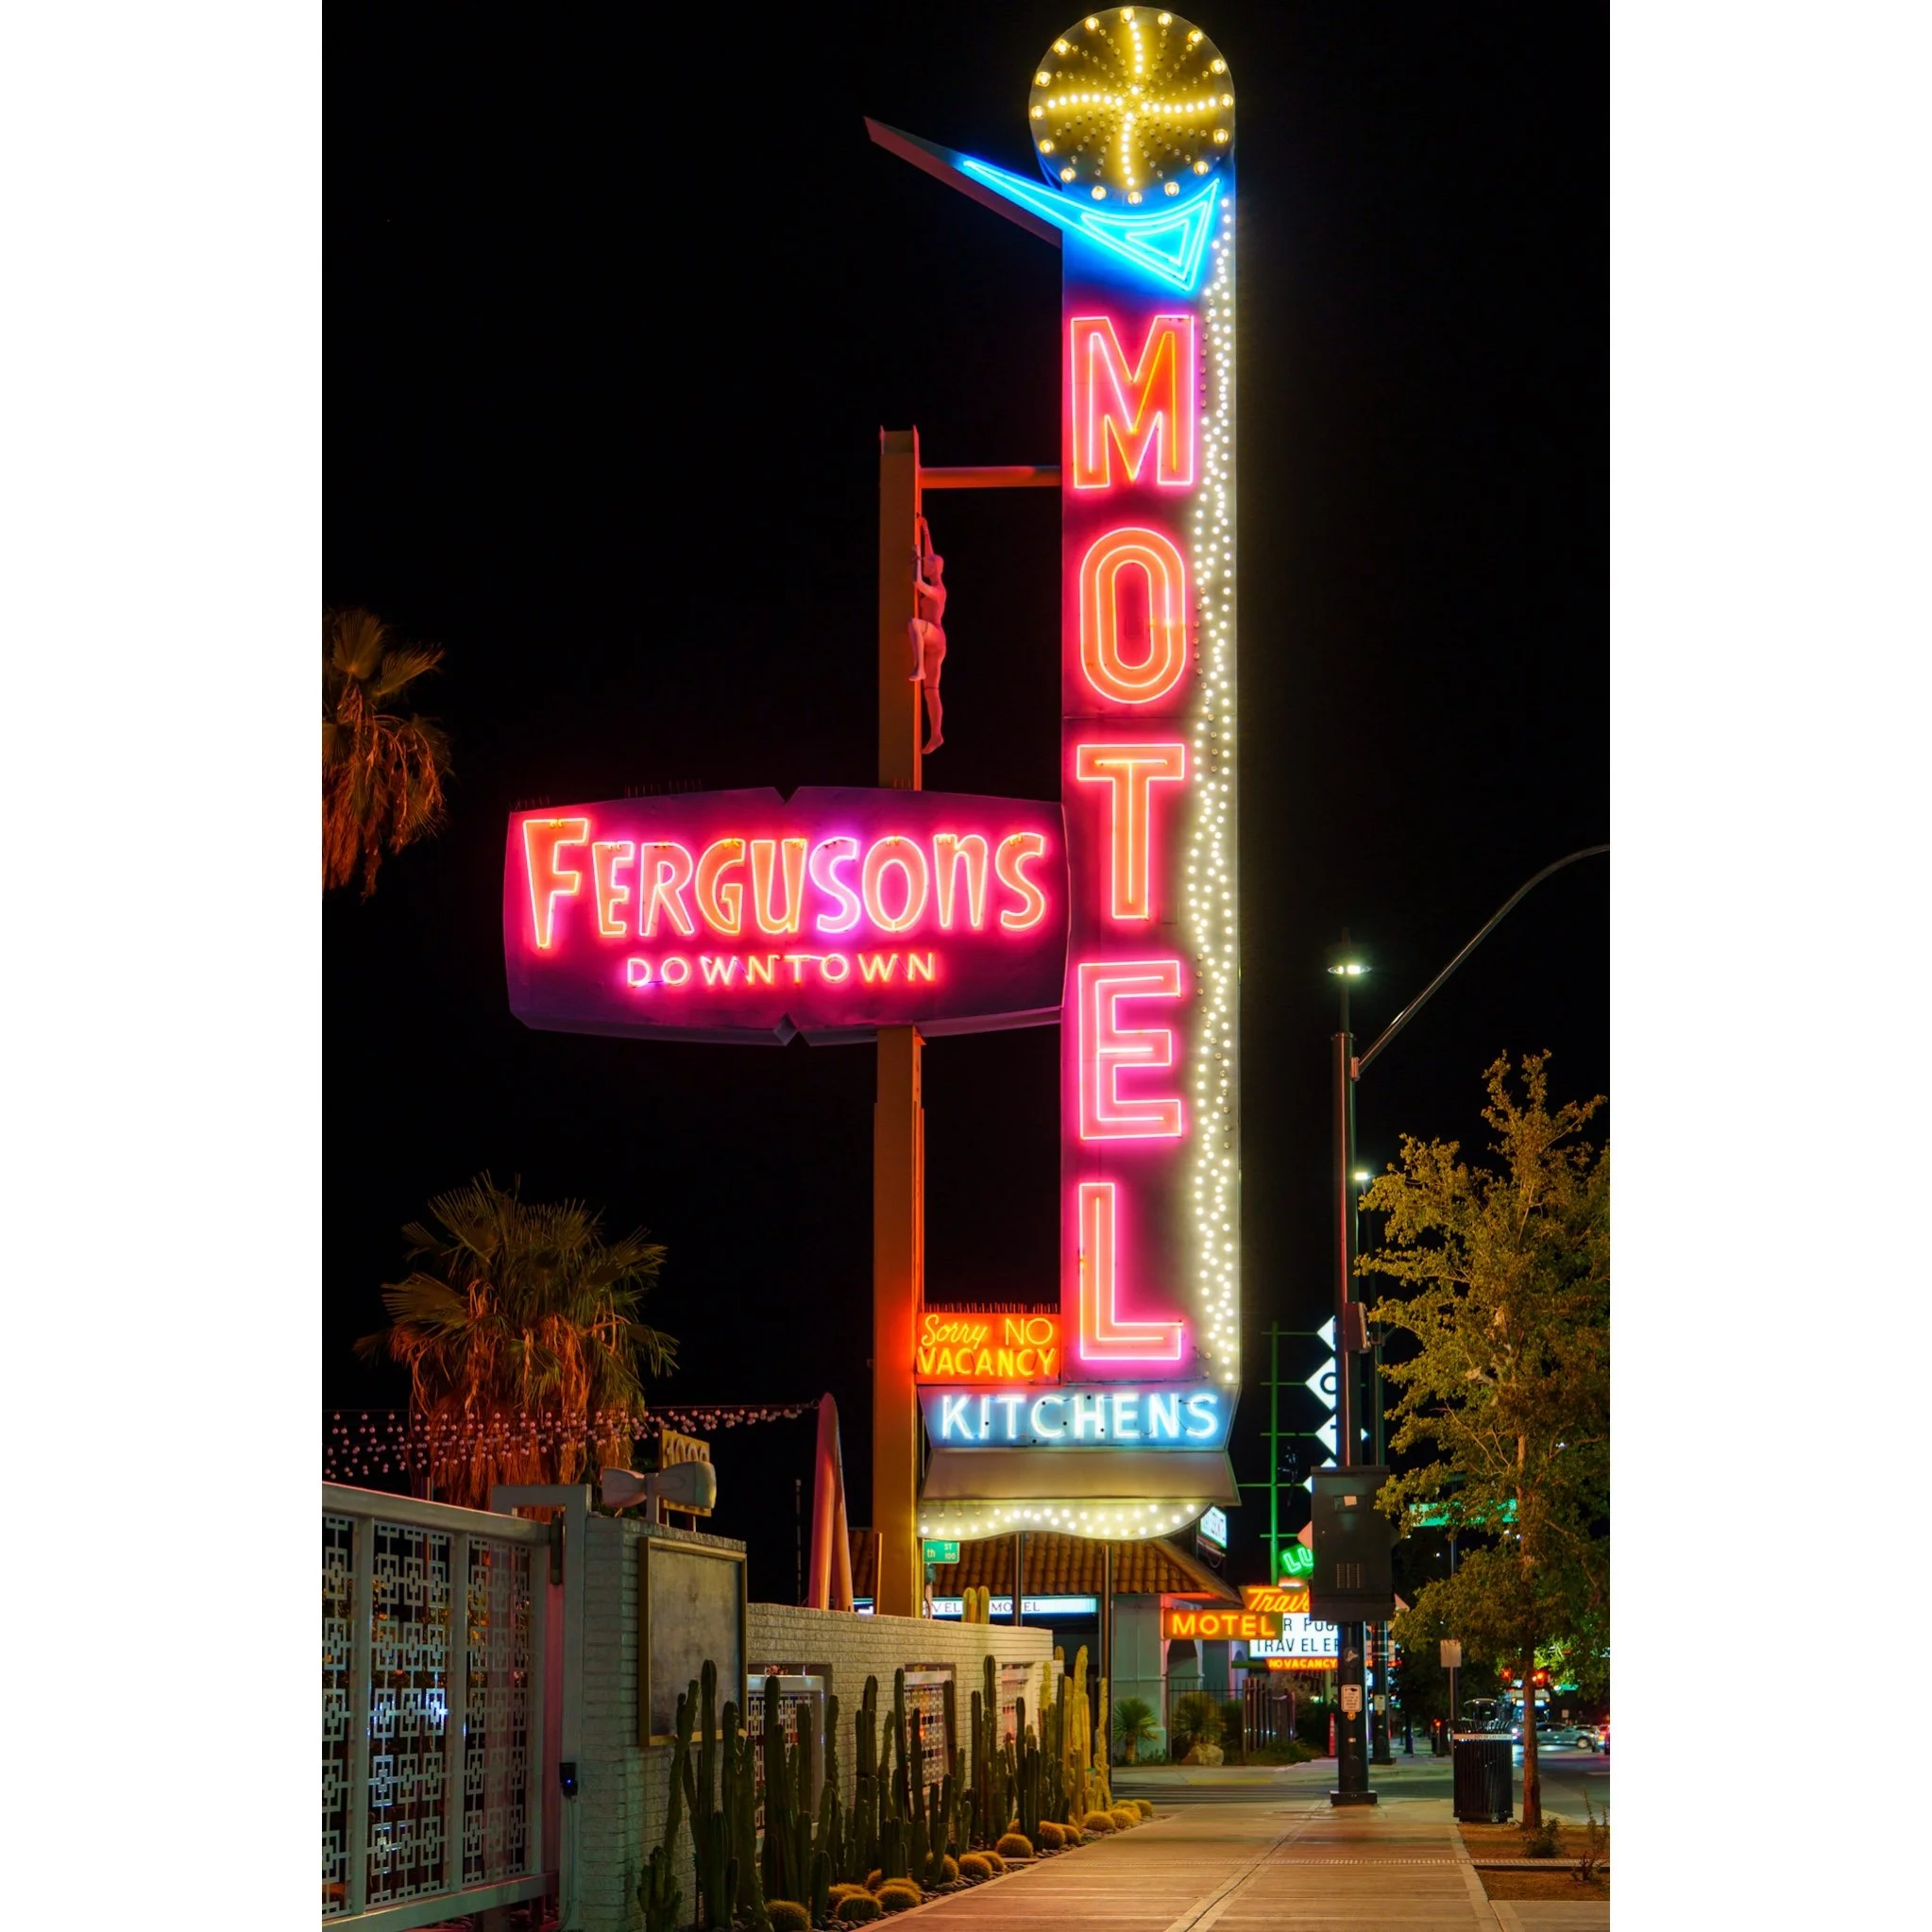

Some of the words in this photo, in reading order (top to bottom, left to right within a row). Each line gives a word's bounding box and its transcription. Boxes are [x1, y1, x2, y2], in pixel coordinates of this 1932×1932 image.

[1070, 314, 1195, 1361] MOTEL
[626, 952, 936, 988] DOWNTOWN
[921, 1313, 988, 1347] Sorry
[1005, 1317, 1054, 1347] NO
[917, 1347, 1056, 1377] VACANCY
[941, 1392, 1219, 1440] KITCHENS
[991, 1602, 1041, 1613] MOEL
[1172, 1614, 1277, 1636] MOTEL
[1268, 1658, 1283, 1669] NO
[1283, 1658, 1338, 1669] VACANCY
